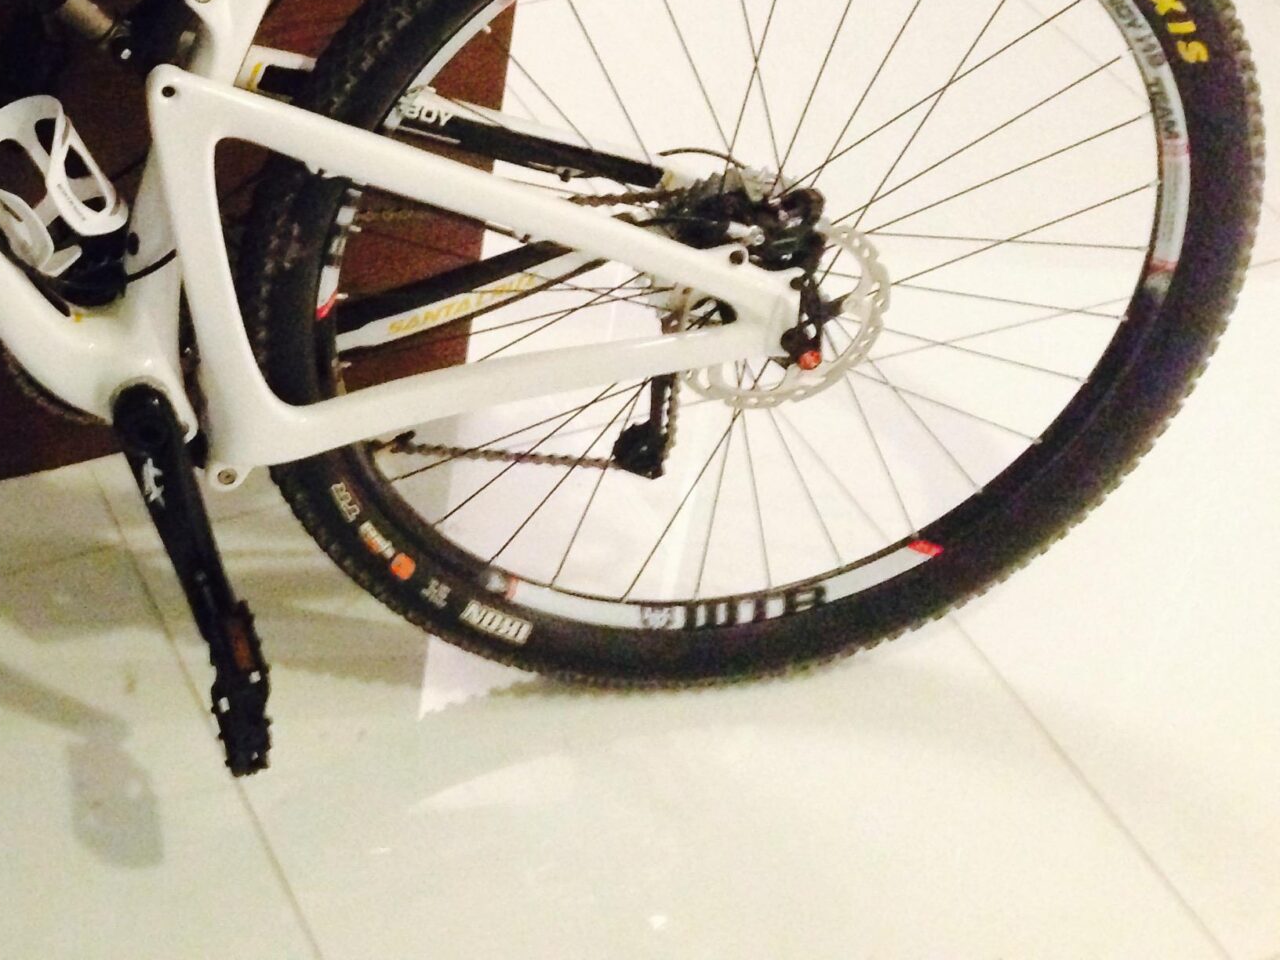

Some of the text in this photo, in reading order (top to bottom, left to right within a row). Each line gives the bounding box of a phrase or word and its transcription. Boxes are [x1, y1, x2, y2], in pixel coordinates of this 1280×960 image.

[1148, 76, 1180, 140] TEAM
[388, 296, 473, 335] SANTA
[459, 599, 533, 645] IKON
